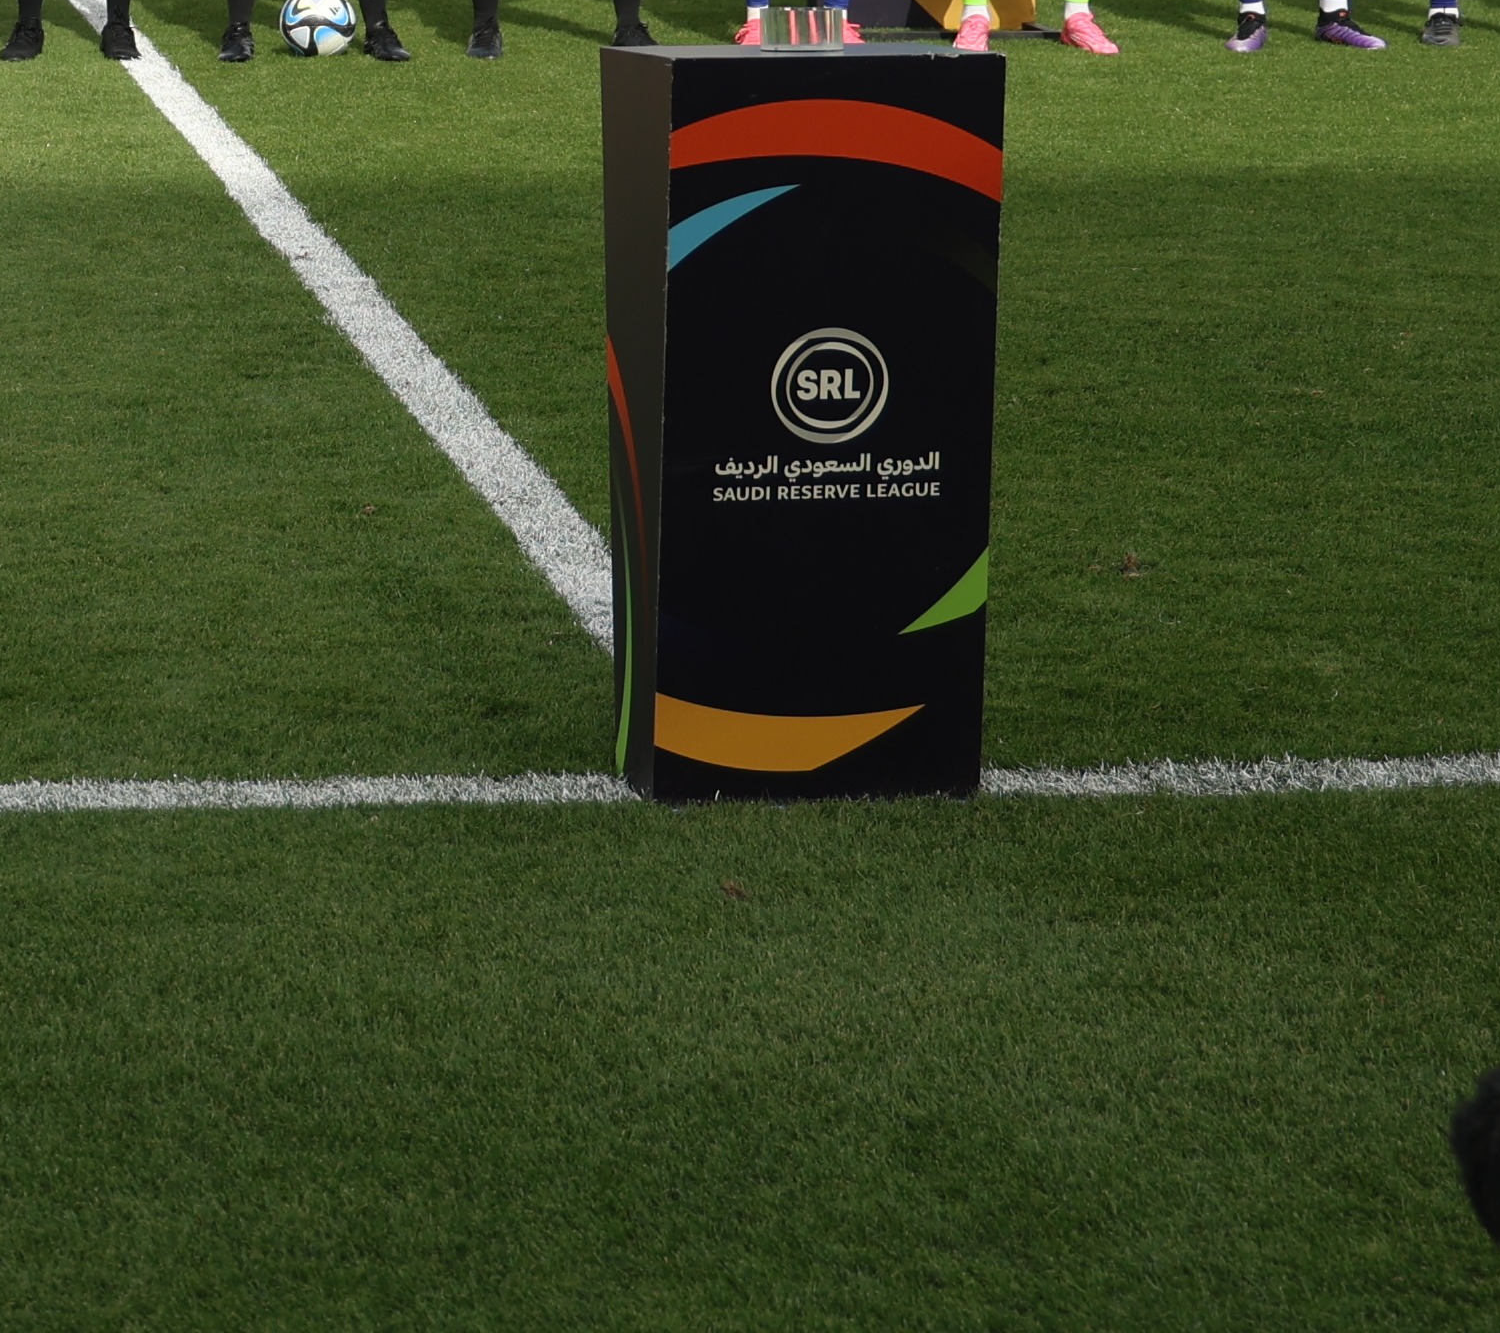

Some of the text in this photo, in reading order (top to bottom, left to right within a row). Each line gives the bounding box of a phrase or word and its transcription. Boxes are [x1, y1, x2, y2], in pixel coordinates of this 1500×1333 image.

[796, 368, 861, 400] SRL
[714, 451, 940, 482] الدوري السعودي الرديف
[713, 482, 940, 502] SAUDI RESERVE LEAGUE
